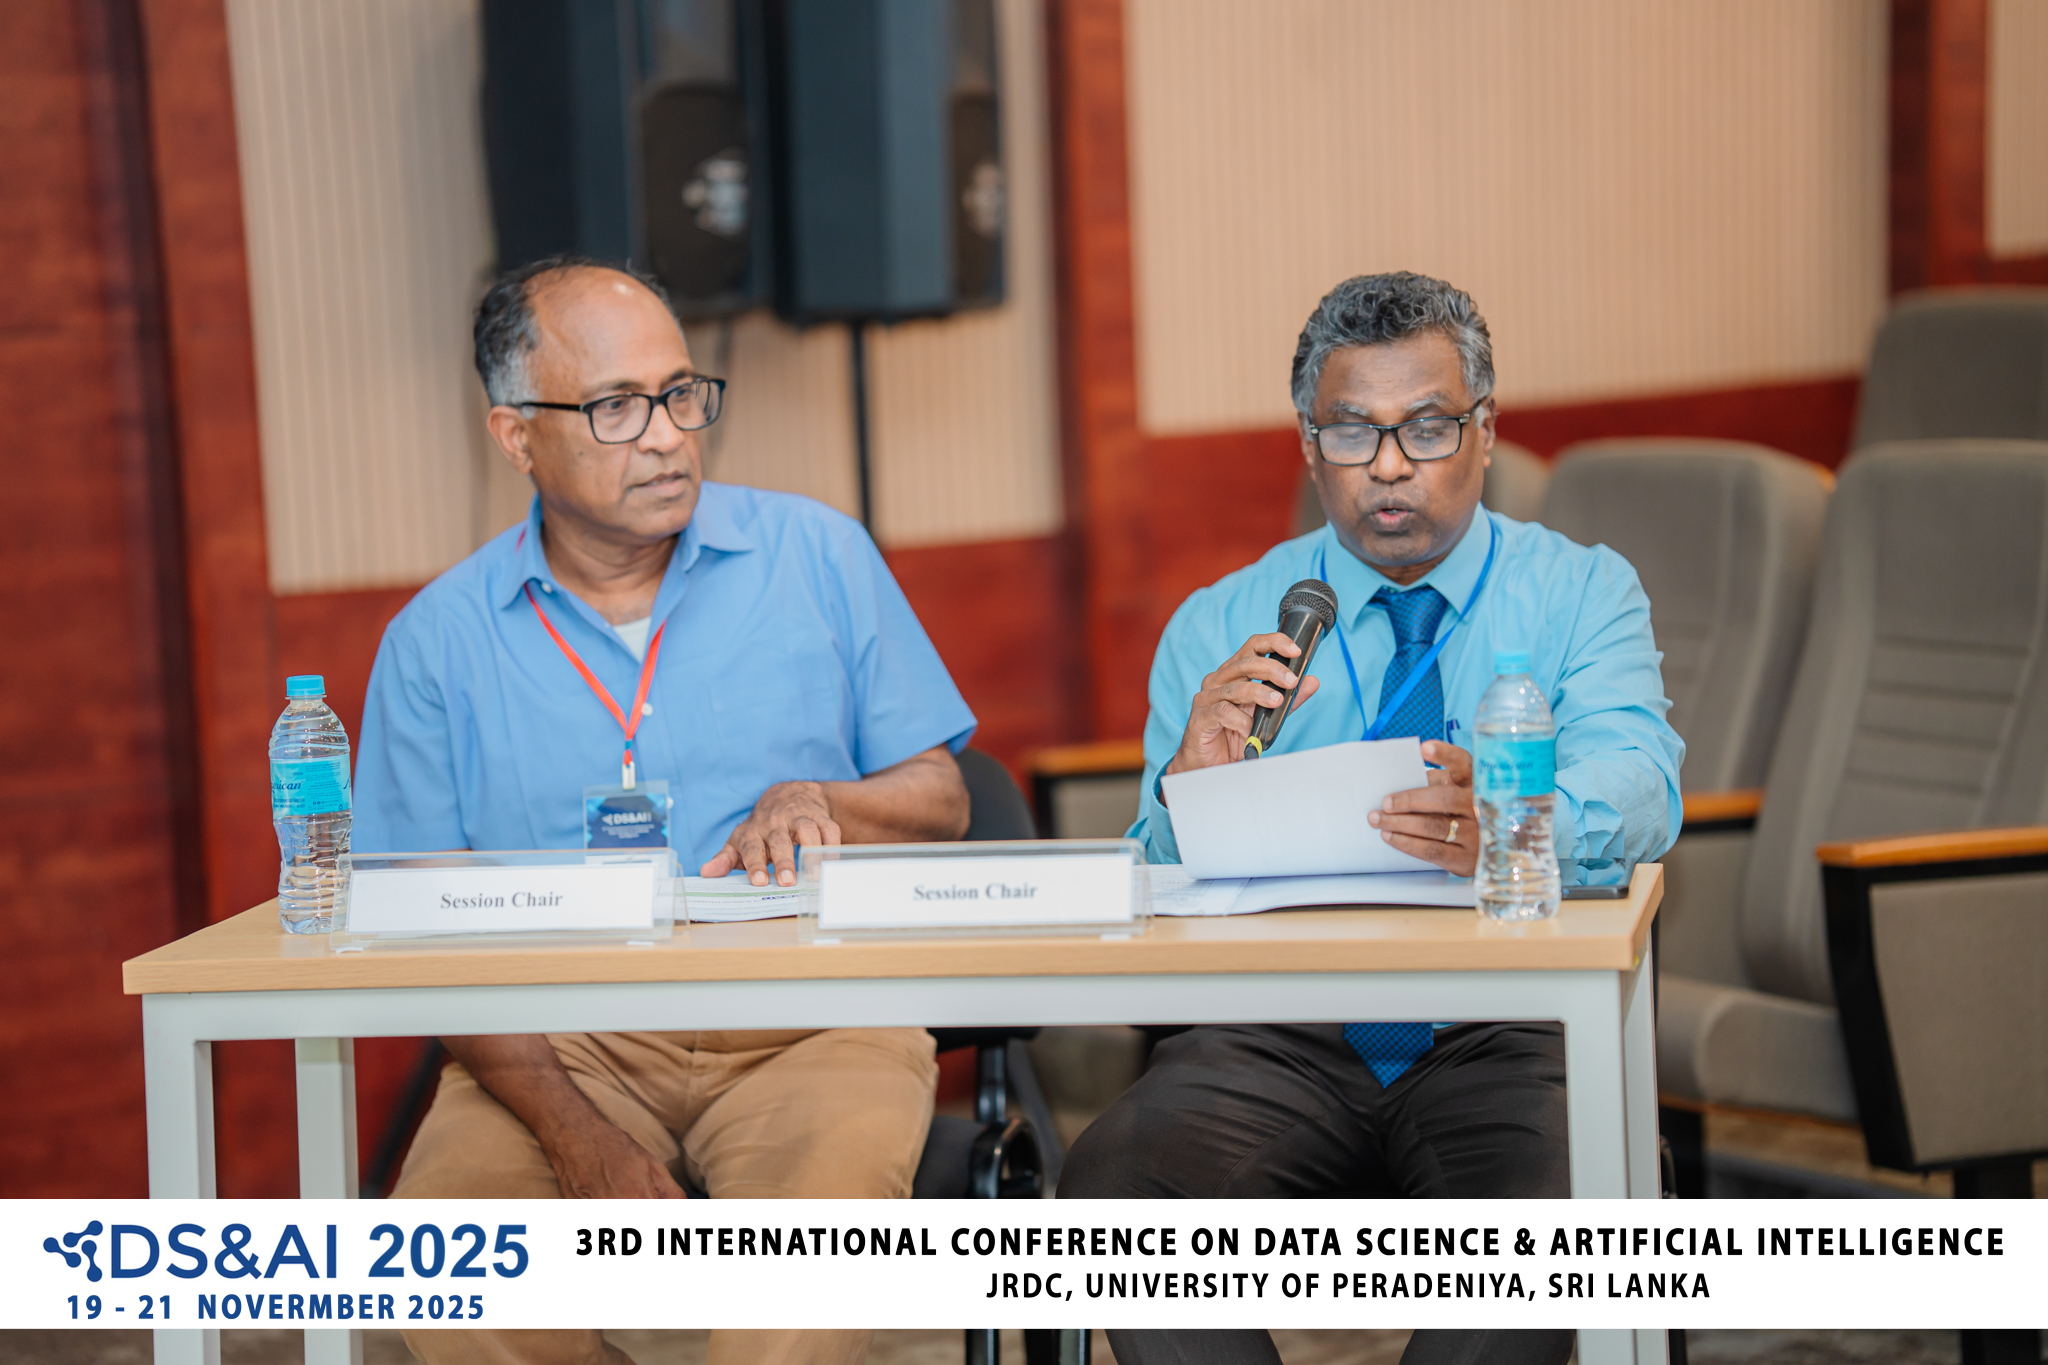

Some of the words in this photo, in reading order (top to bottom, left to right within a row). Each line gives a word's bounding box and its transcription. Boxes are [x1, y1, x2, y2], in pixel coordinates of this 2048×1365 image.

[440, 893, 505, 909] Session
[511, 891, 563, 908] Chair
[913, 884, 979, 901] Session
[984, 881, 1039, 900] Chair
